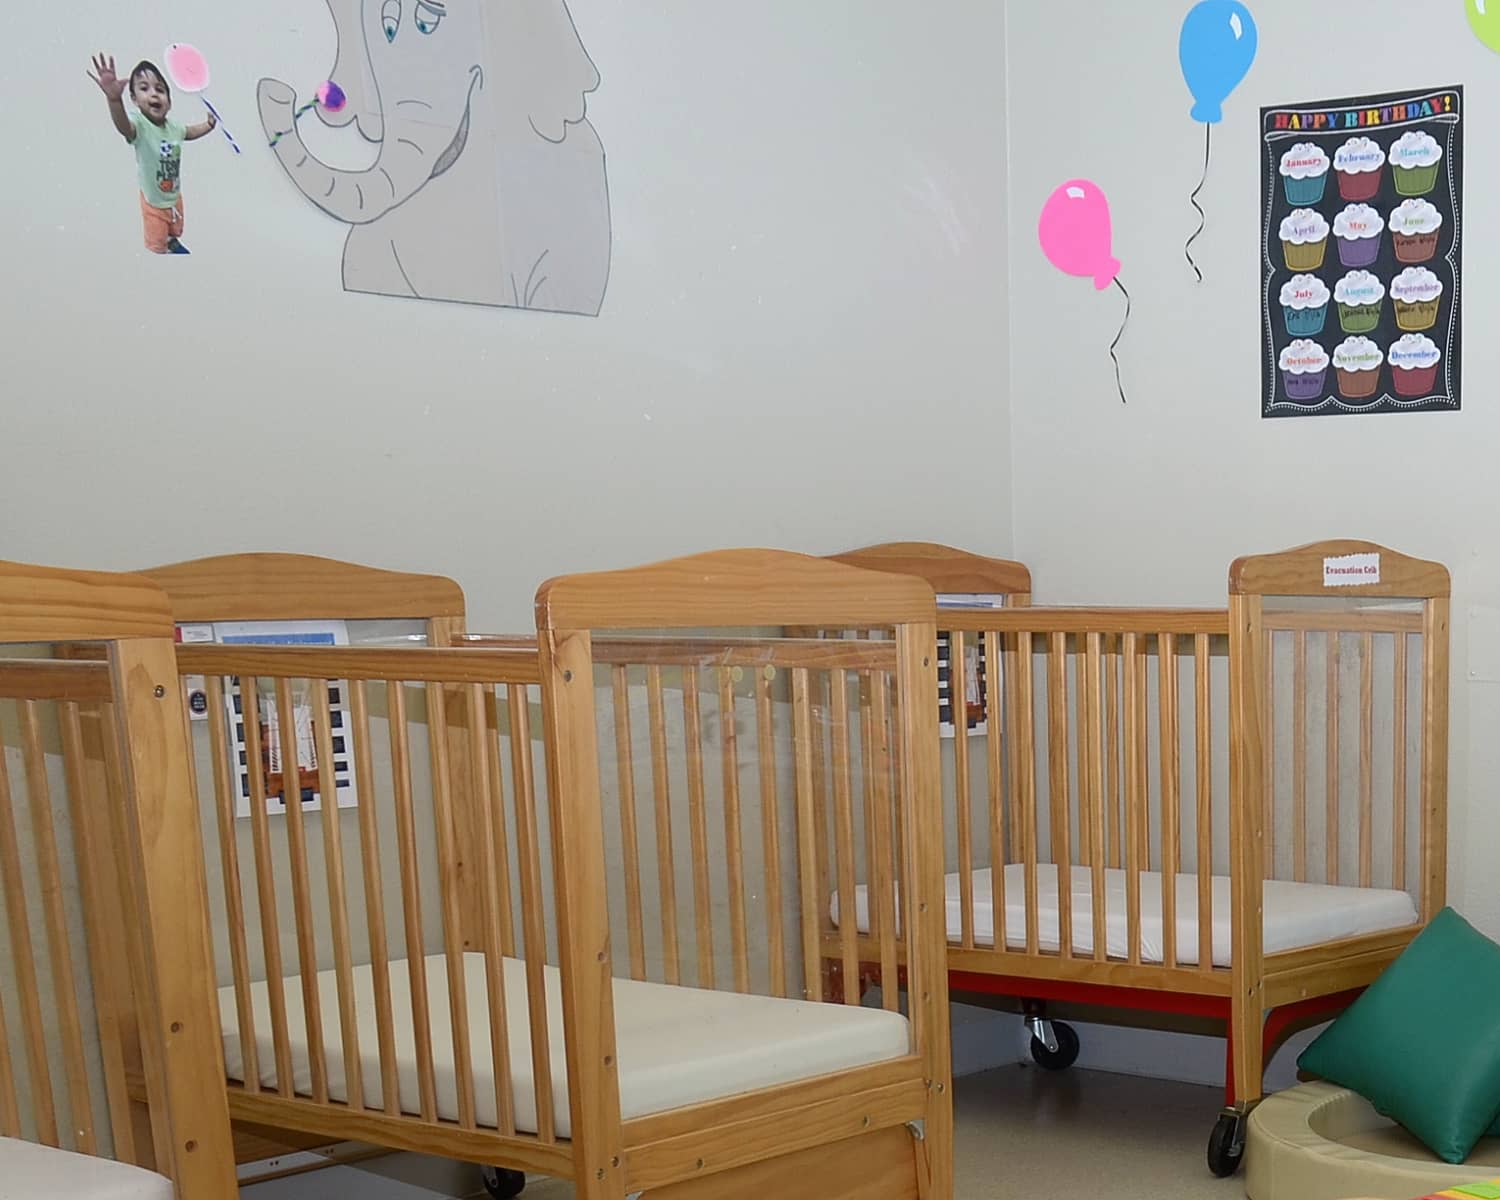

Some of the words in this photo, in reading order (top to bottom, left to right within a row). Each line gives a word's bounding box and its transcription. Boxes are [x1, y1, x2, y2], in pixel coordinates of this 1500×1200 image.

[1274, 111, 1340, 130] HAPPY
[1345, 95, 1452, 127] BIRTHDAY!
[1400, 147, 1430, 156] March
[1286, 157, 1322, 168] January
[1338, 153, 1380, 163] February
[1349, 221, 1367, 231] May
[1403, 217, 1424, 226] June
[1293, 225, 1315, 236] April
[1344, 287, 1374, 297] August
[1395, 283, 1439, 294] September
[1294, 290, 1313, 299] July
[1337, 353, 1380, 362] November
[1391, 350, 1437, 360] December
[1286, 357, 1322, 366] October
[1326, 566, 1363, 575] Evacuation
[1364, 566, 1377, 574] Crib
